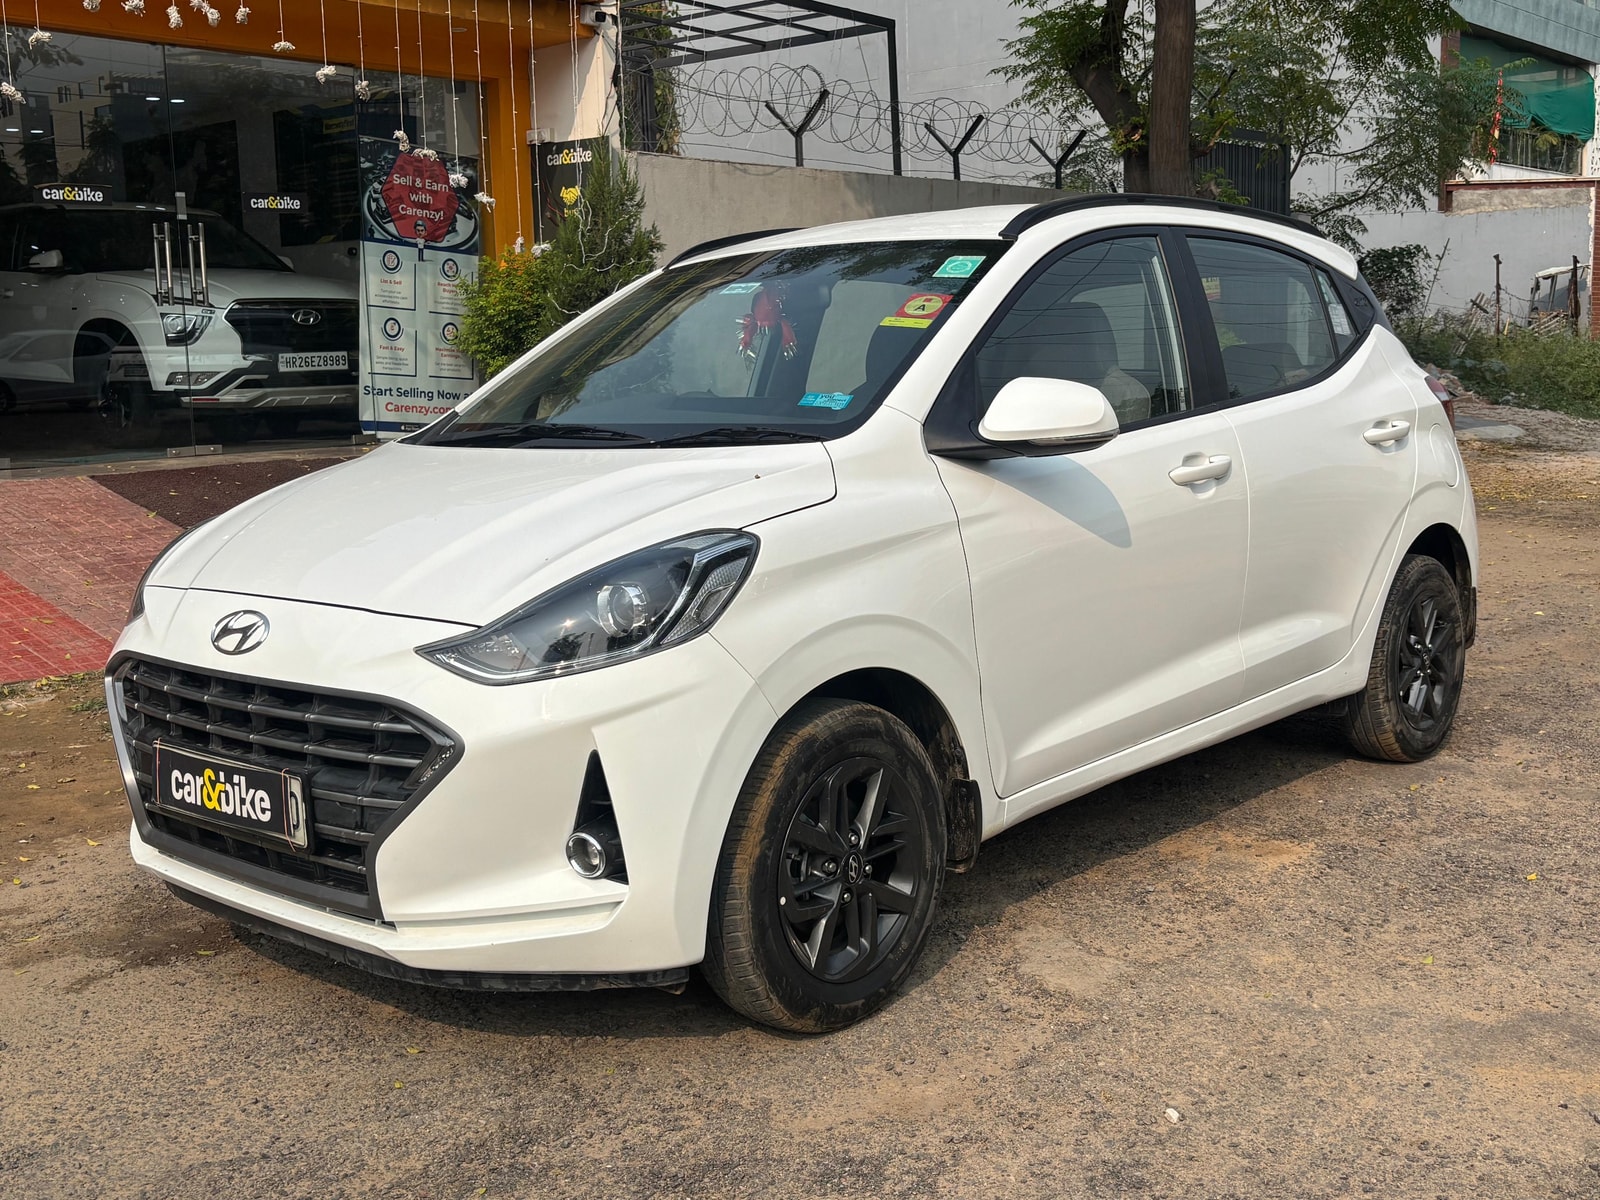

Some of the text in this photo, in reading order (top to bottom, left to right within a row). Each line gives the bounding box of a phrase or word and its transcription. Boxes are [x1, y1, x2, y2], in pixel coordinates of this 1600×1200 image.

[546, 147, 593, 166] car&bike
[392, 173, 449, 193] Sell & Earn
[42, 186, 104, 202] car&bike
[409, 191, 433, 205] with
[250, 196, 301, 210] car&bike
[398, 204, 444, 222] Carenzy!
[913, 303, 926, 312] A
[285, 354, 347, 369] HR26EZ8989
[363, 385, 474, 401] Start Selling Now a
[171, 767, 272, 823] car&bike
